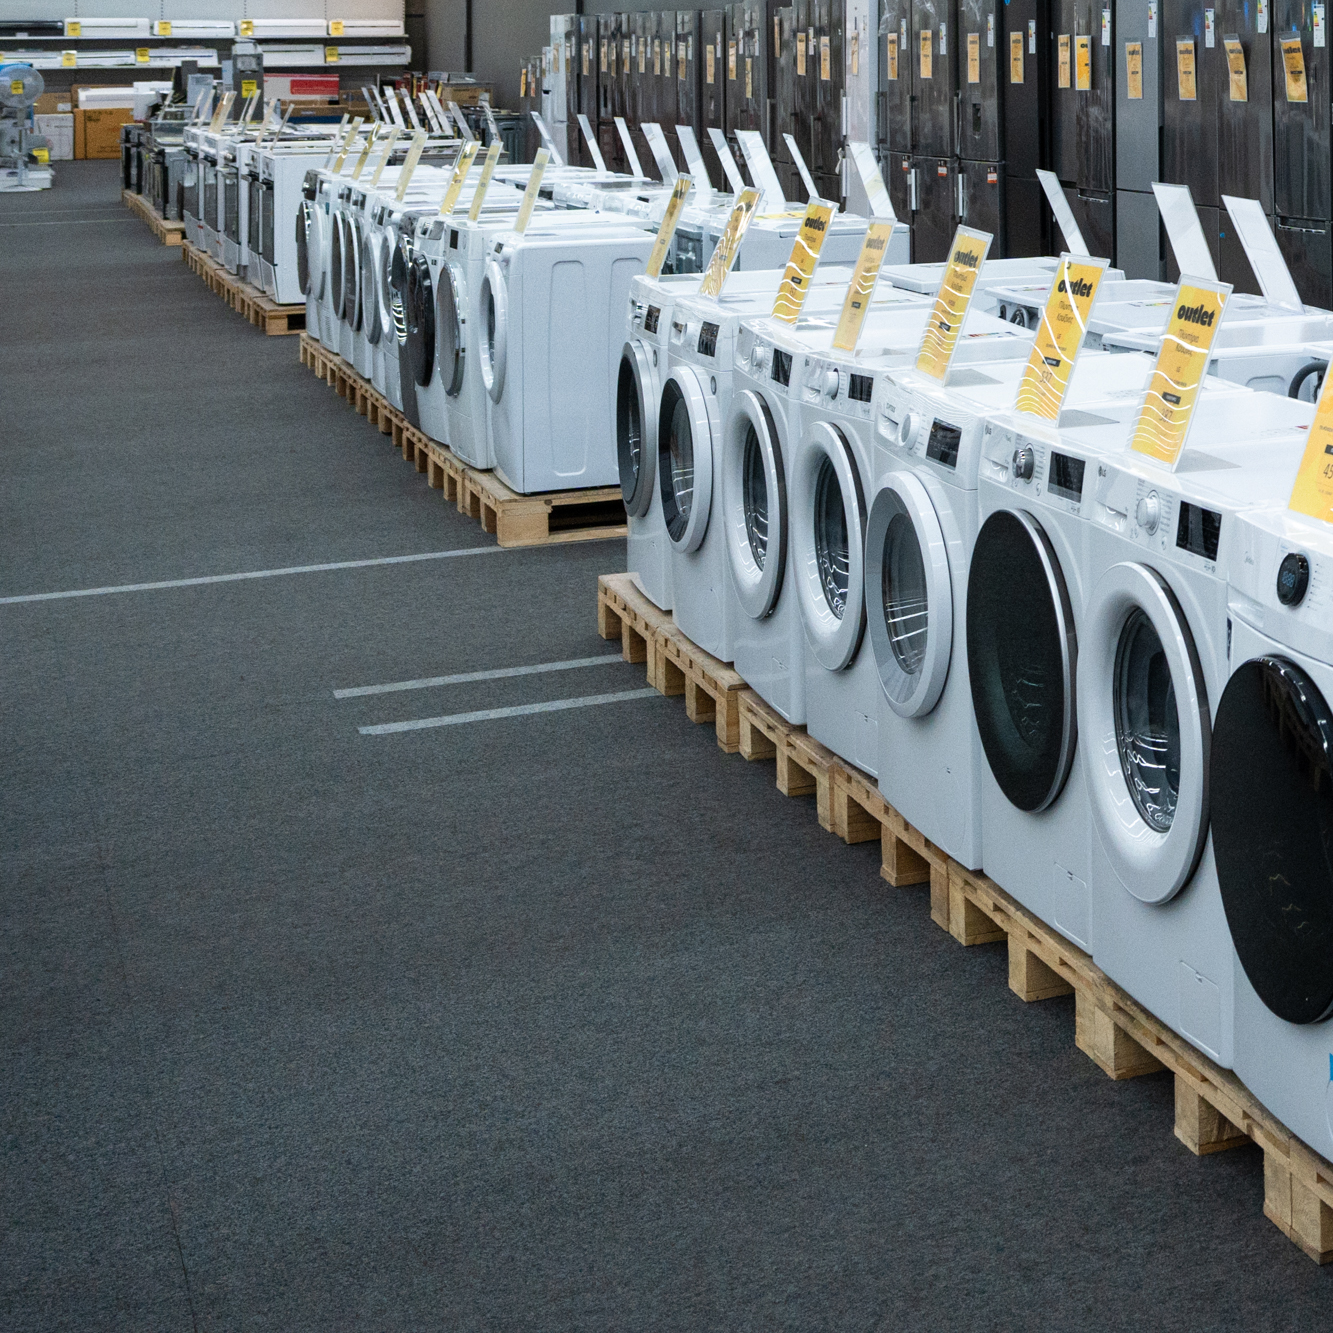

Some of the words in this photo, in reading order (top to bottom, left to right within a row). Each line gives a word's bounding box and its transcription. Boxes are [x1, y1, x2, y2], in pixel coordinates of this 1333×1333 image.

[804, 216, 827, 232] outlet
[954, 249, 978, 268] outlet
[1177, 304, 1215, 327] outlet
